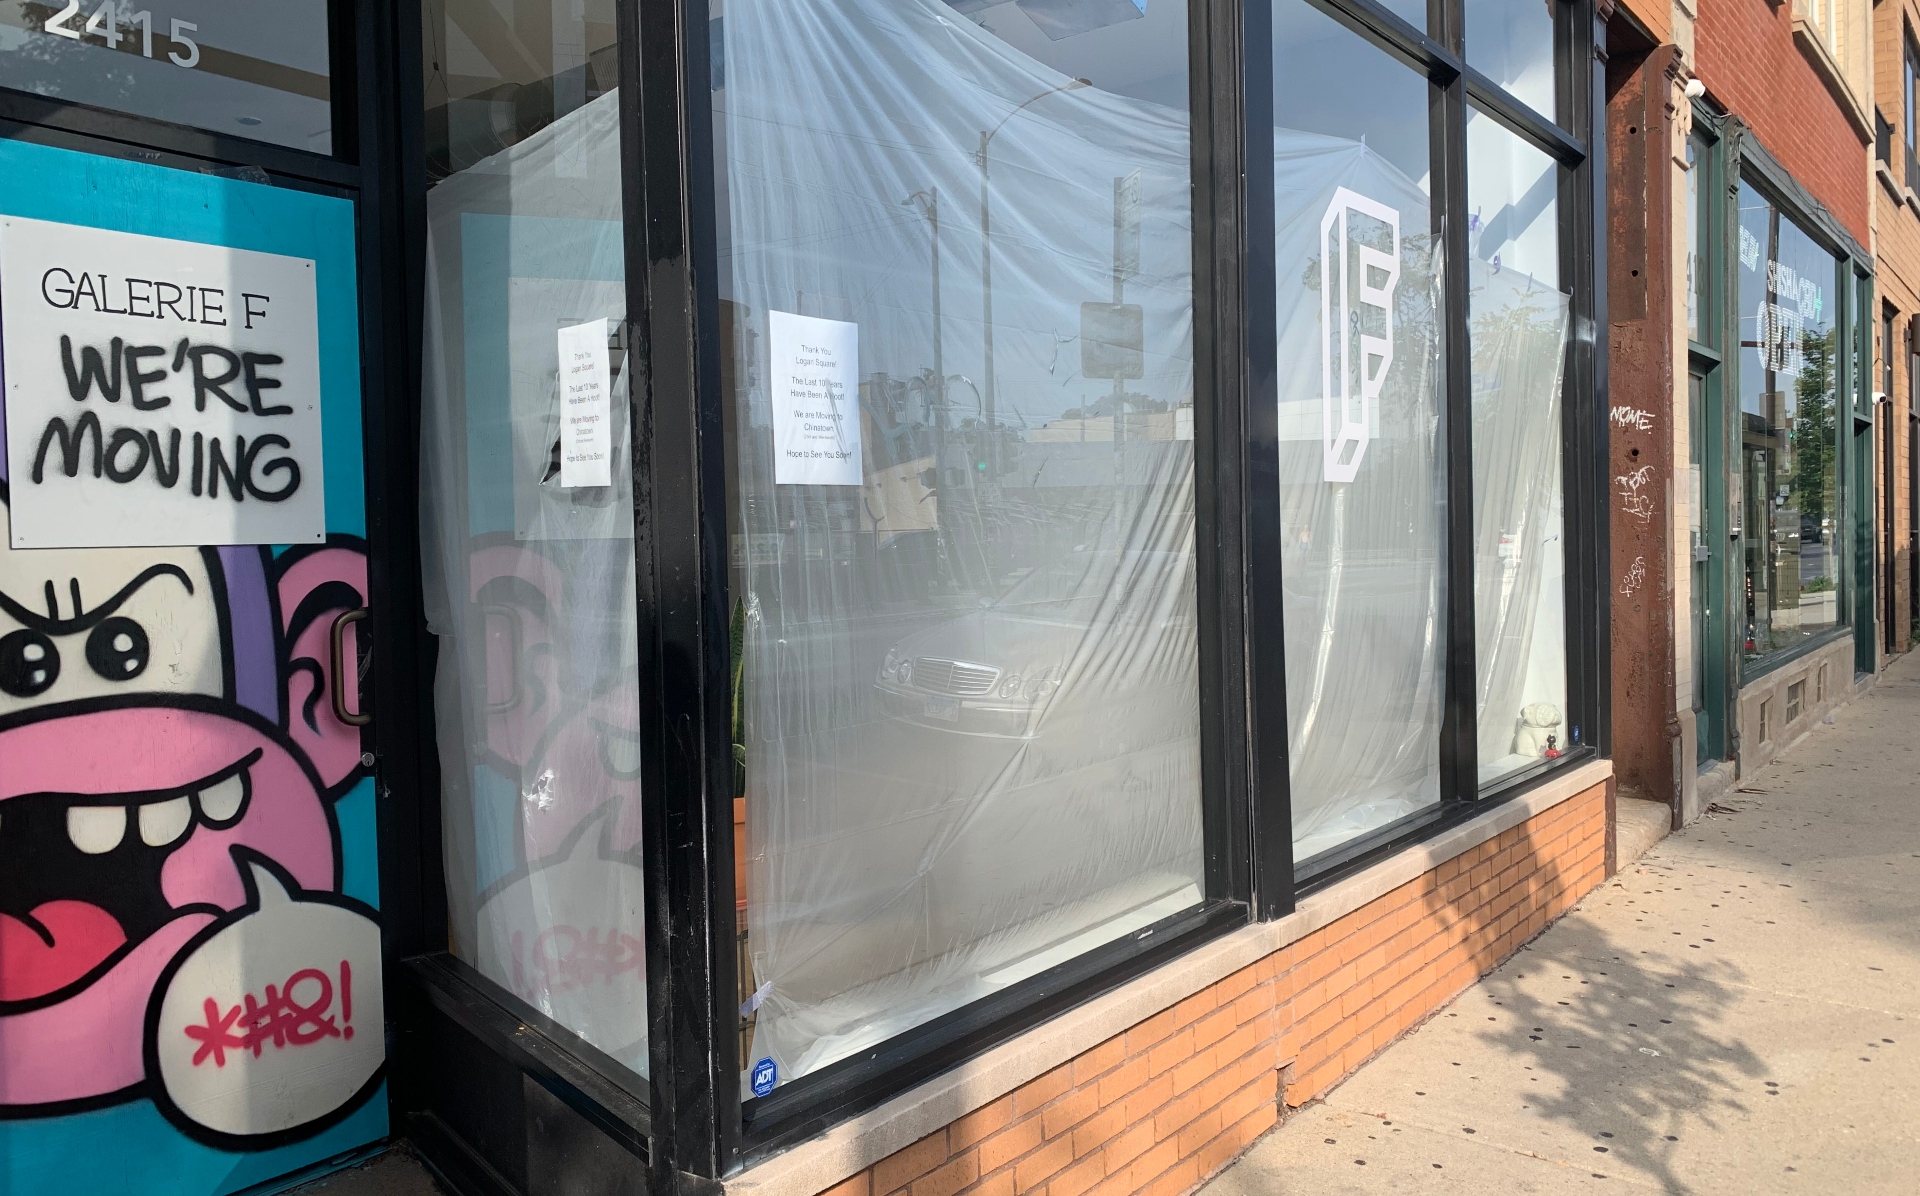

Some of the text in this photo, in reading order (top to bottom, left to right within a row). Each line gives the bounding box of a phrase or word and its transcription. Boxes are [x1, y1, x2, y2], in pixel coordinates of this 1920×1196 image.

[44, 0, 201, 69] 2415
[1767, 259, 1798, 301] SHISHA
[41, 267, 270, 329] GALERIE F
[1757, 300, 1804, 378] OPEN
[801, 344, 832, 356] Thank You
[795, 356, 837, 368] Logan Square!
[60, 335, 293, 417] WE'RE
[791, 376, 804, 385] The
[804, 377, 818, 386] Last
[819, 379, 826, 387] 10
[790, 388, 806, 398] Have
[807, 390, 823, 399] Been
[824, 391, 829, 400] A
[793, 410, 804, 419] We
[815, 411, 836, 422] Moving
[803, 422, 834, 432] Chinatown
[31, 411, 301, 502] MOVING
[786, 449, 852, 459] Hope to See You Soon!
[756, 1067, 773, 1086] ADT
